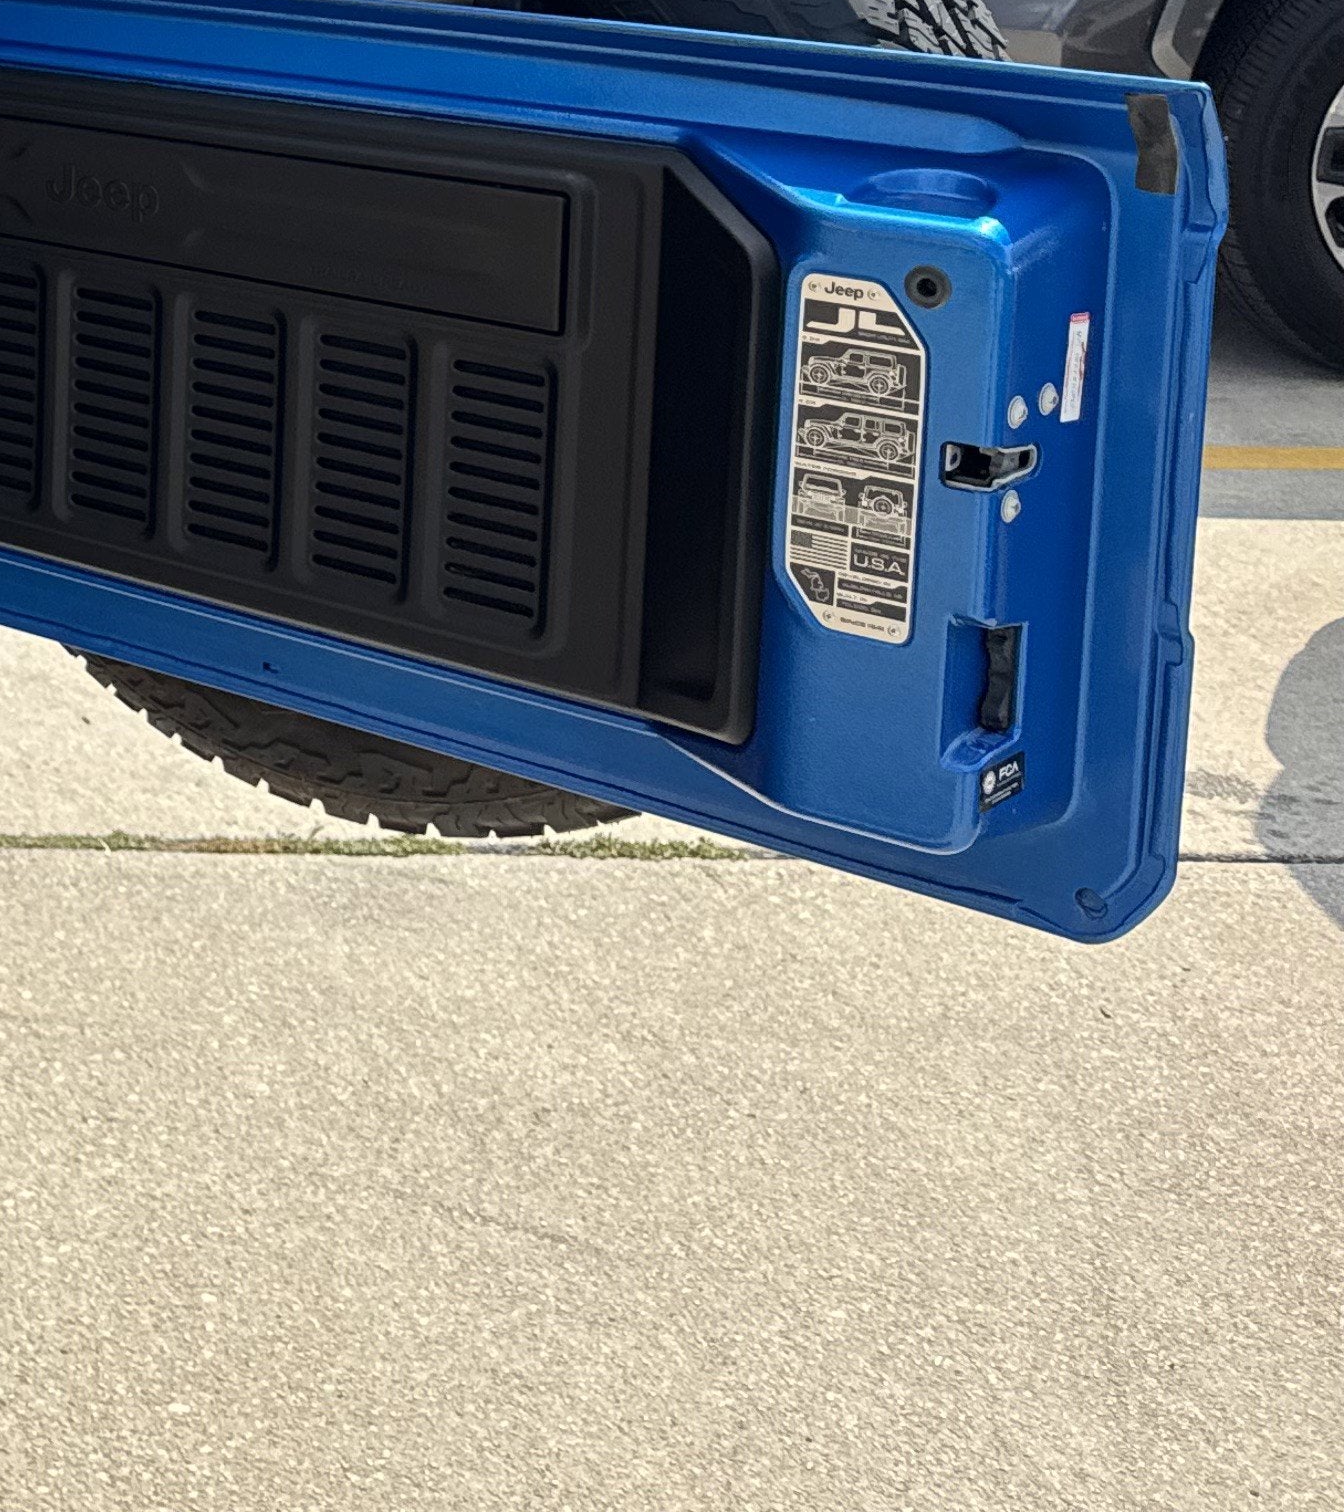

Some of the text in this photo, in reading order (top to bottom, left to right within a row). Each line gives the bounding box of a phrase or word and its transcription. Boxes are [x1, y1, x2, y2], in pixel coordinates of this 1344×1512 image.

[45, 165, 160, 223] Jeep
[824, 281, 864, 300] Jeep
[806, 307, 906, 336] JL
[998, 760, 1019, 781] FCA
